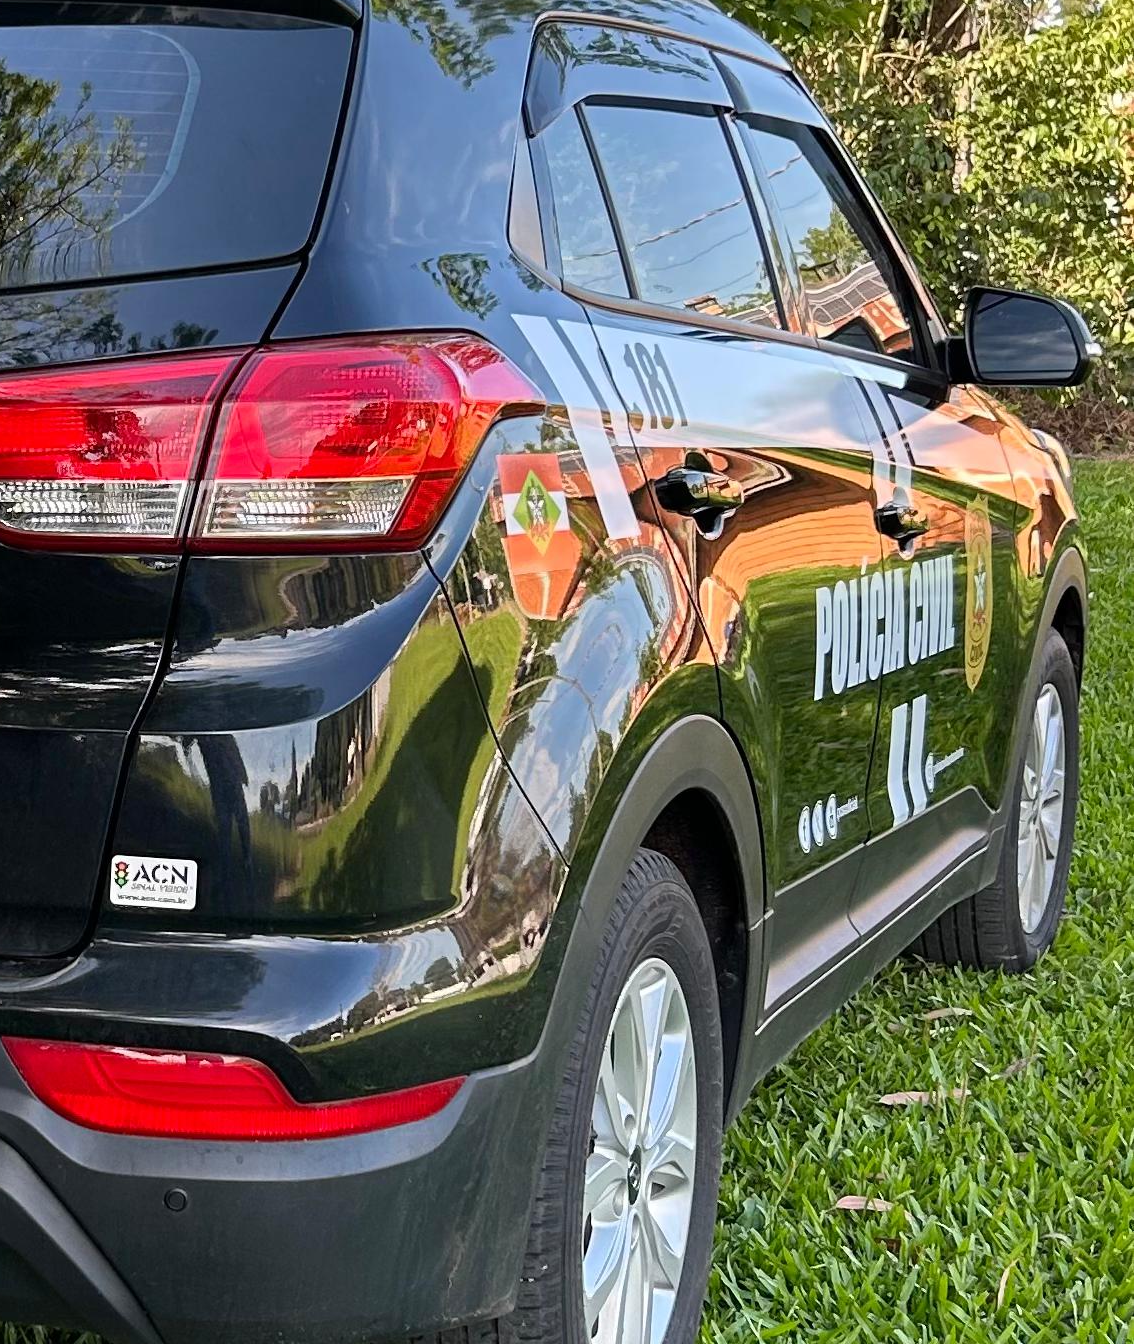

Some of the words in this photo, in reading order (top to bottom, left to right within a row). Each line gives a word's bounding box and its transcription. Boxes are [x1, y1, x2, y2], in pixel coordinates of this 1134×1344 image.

[623, 342, 688, 429] 181
[813, 556, 905, 701] POLÍCIA
[908, 554, 955, 665] CIVIL
[132, 861, 188, 885] ACN
